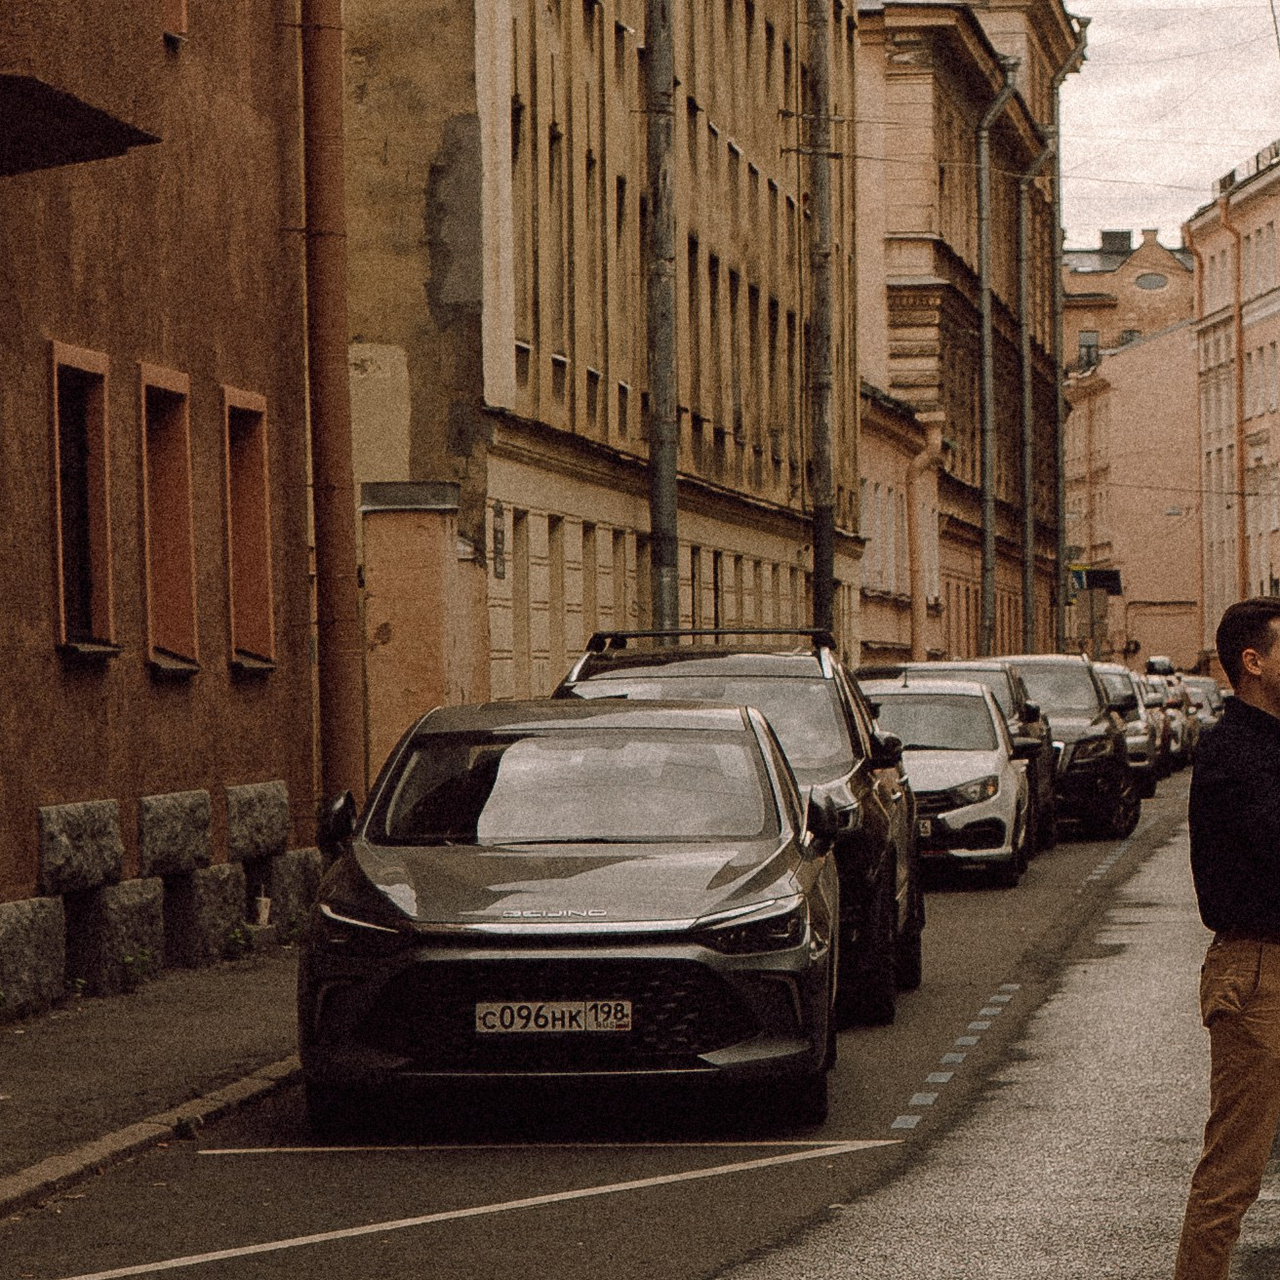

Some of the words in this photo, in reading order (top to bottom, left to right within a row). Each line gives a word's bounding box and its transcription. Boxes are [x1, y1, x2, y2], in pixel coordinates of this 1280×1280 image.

[482, 1004, 582, 1029] С096НК
[588, 1002, 625, 1021] 198
[596, 1020, 615, 1029] RUS
